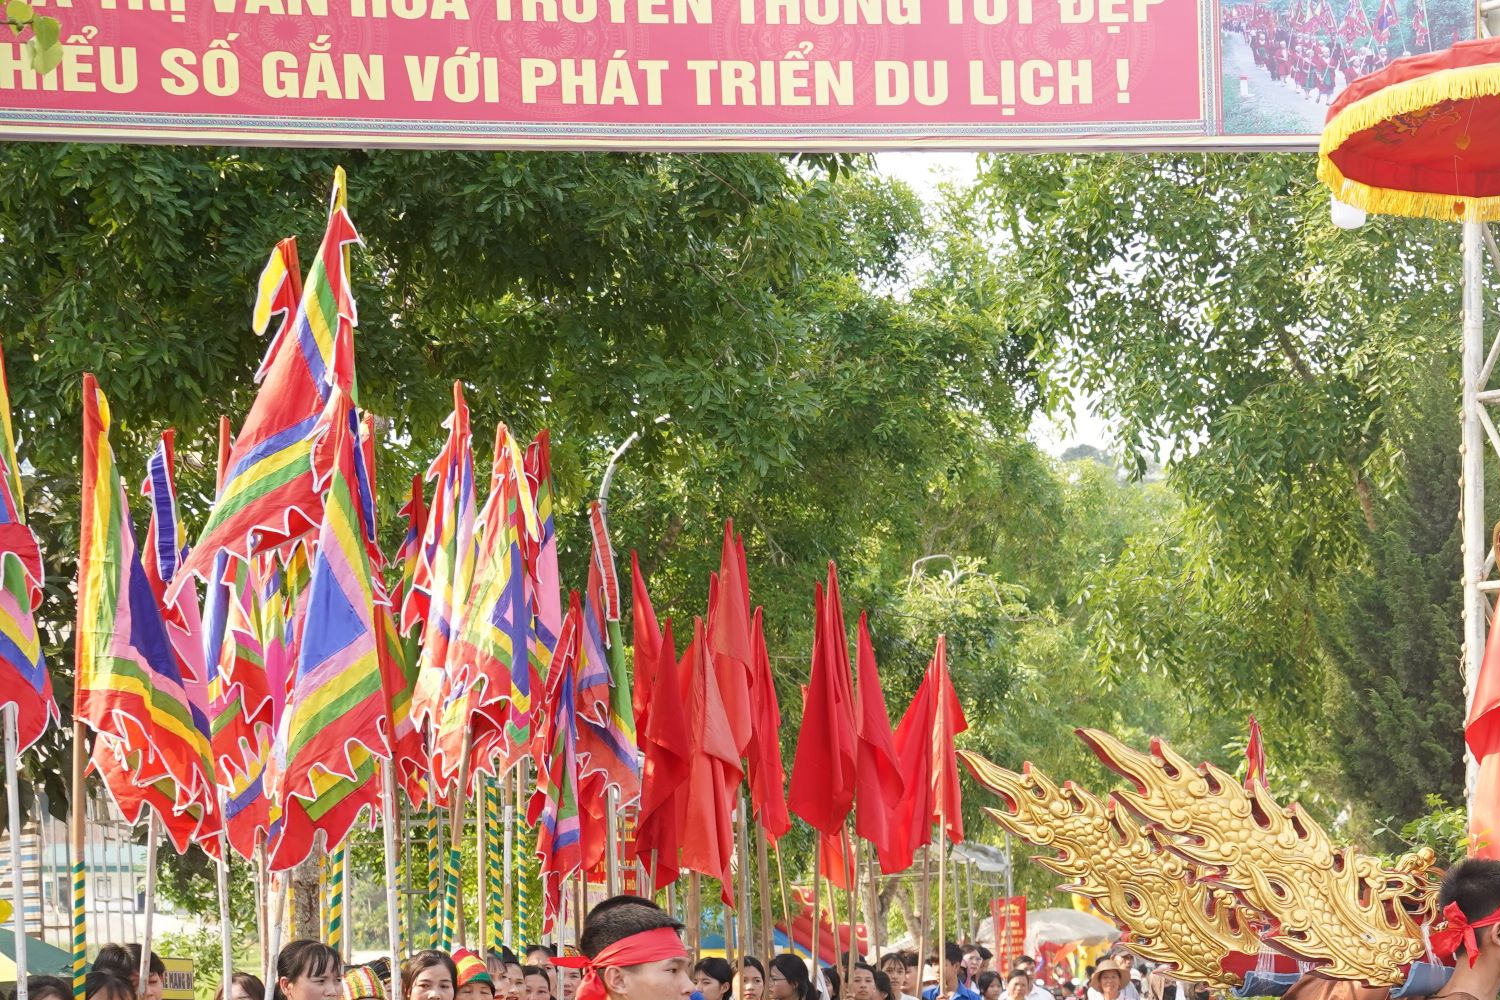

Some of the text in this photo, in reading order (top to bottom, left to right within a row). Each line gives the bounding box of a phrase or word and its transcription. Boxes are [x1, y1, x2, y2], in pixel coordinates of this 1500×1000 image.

[160, 32, 240, 97] SỐ
[262, 34, 385, 101] GẮN
[403, 46, 500, 103] VỚI
[520, 49, 669, 106] PHÁT
[687, 40, 854, 106] TRIỂN
[874, 60, 949, 106] DU
[969, 59, 1093, 116] LỊCH
